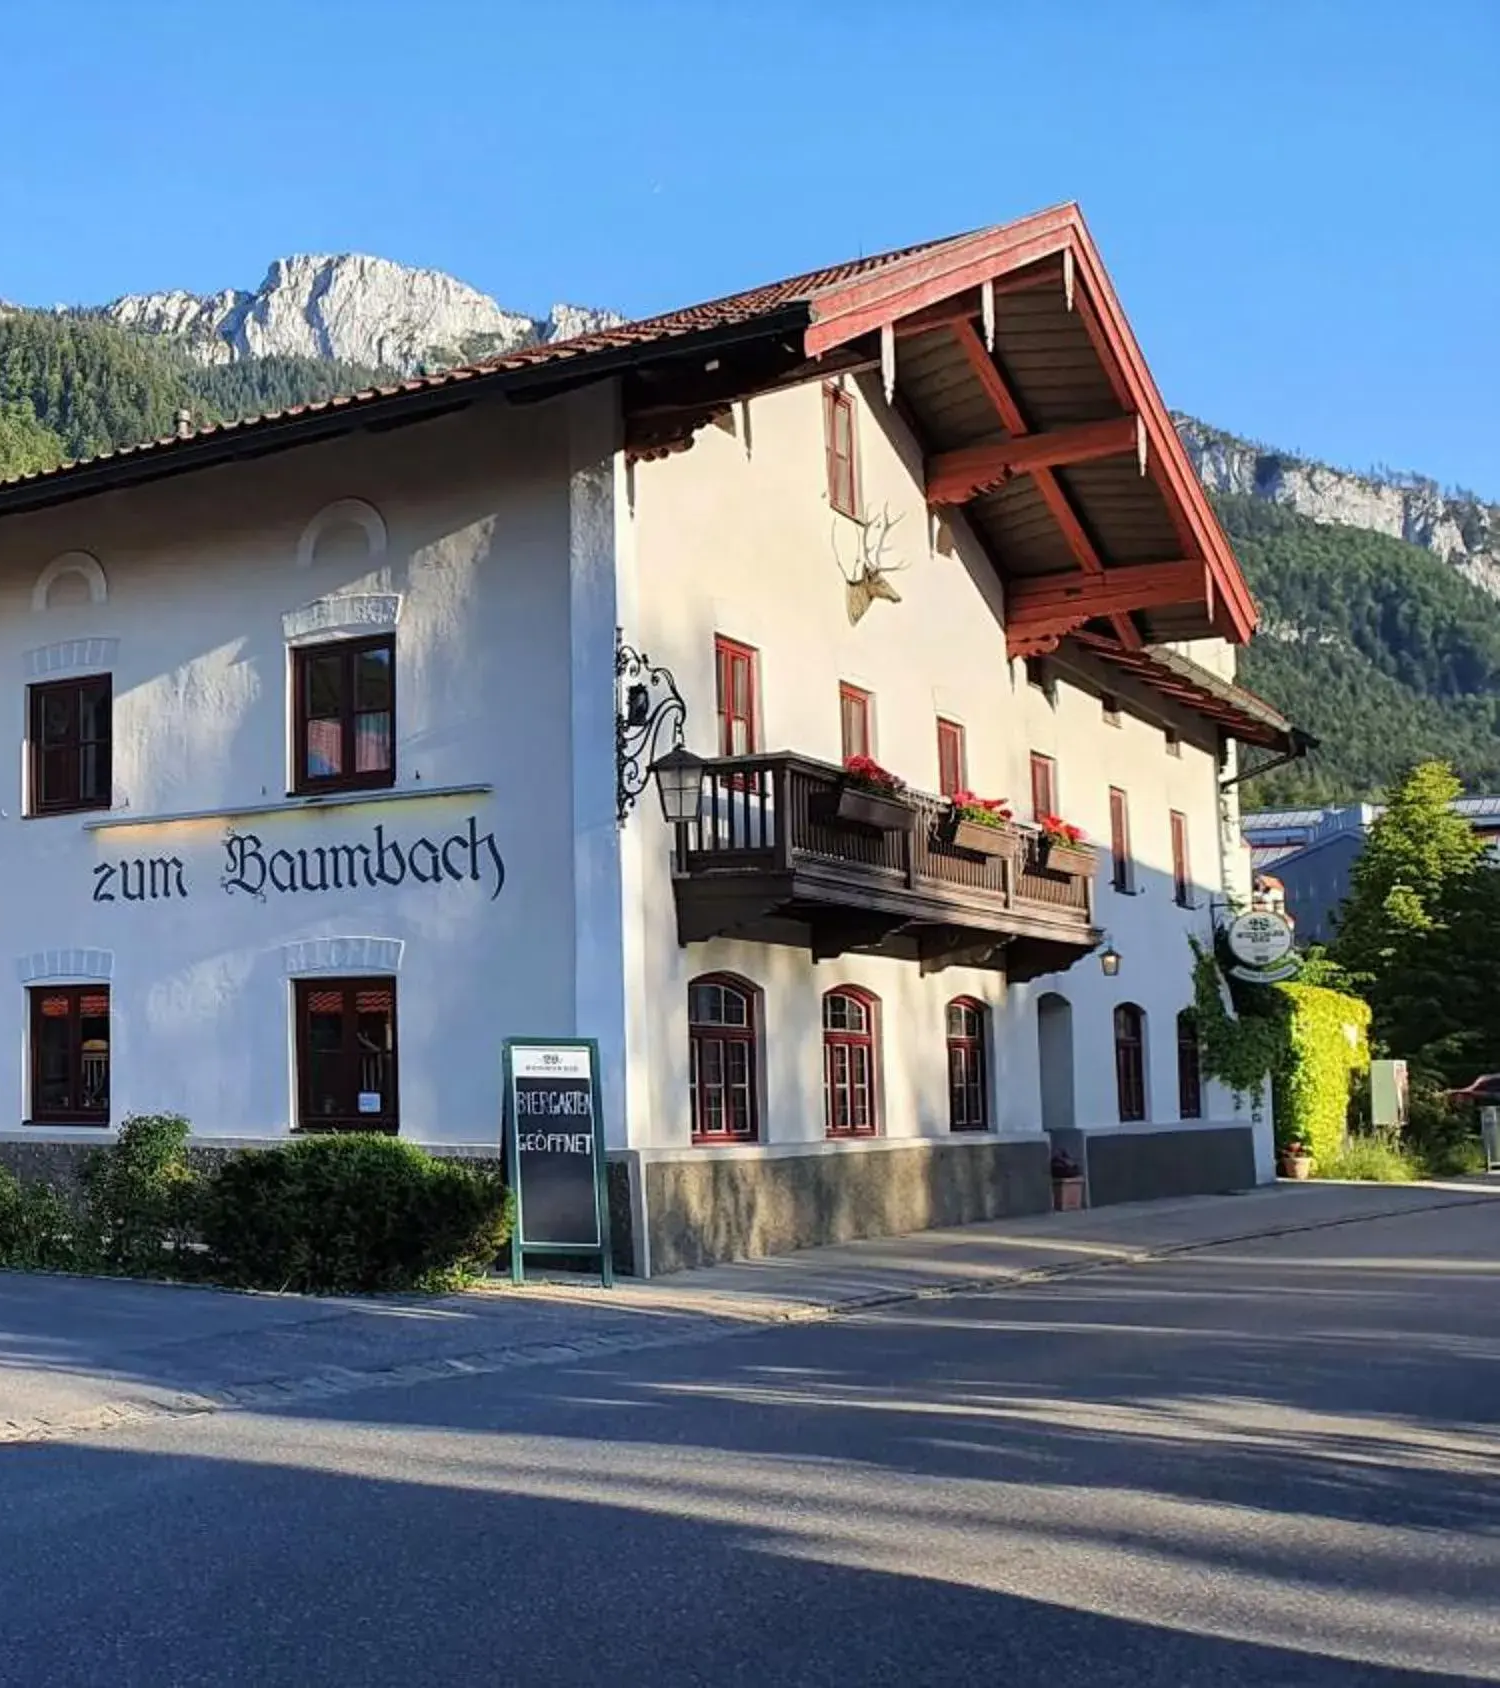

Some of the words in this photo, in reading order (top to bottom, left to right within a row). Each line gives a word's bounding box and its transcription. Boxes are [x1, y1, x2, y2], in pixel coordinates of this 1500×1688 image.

[93, 854, 188, 902] zum
[220, 815, 506, 904] Baumbach
[516, 1090, 592, 1116] BIERGARTEN
[517, 1128, 592, 1155] GEÖFFNET
